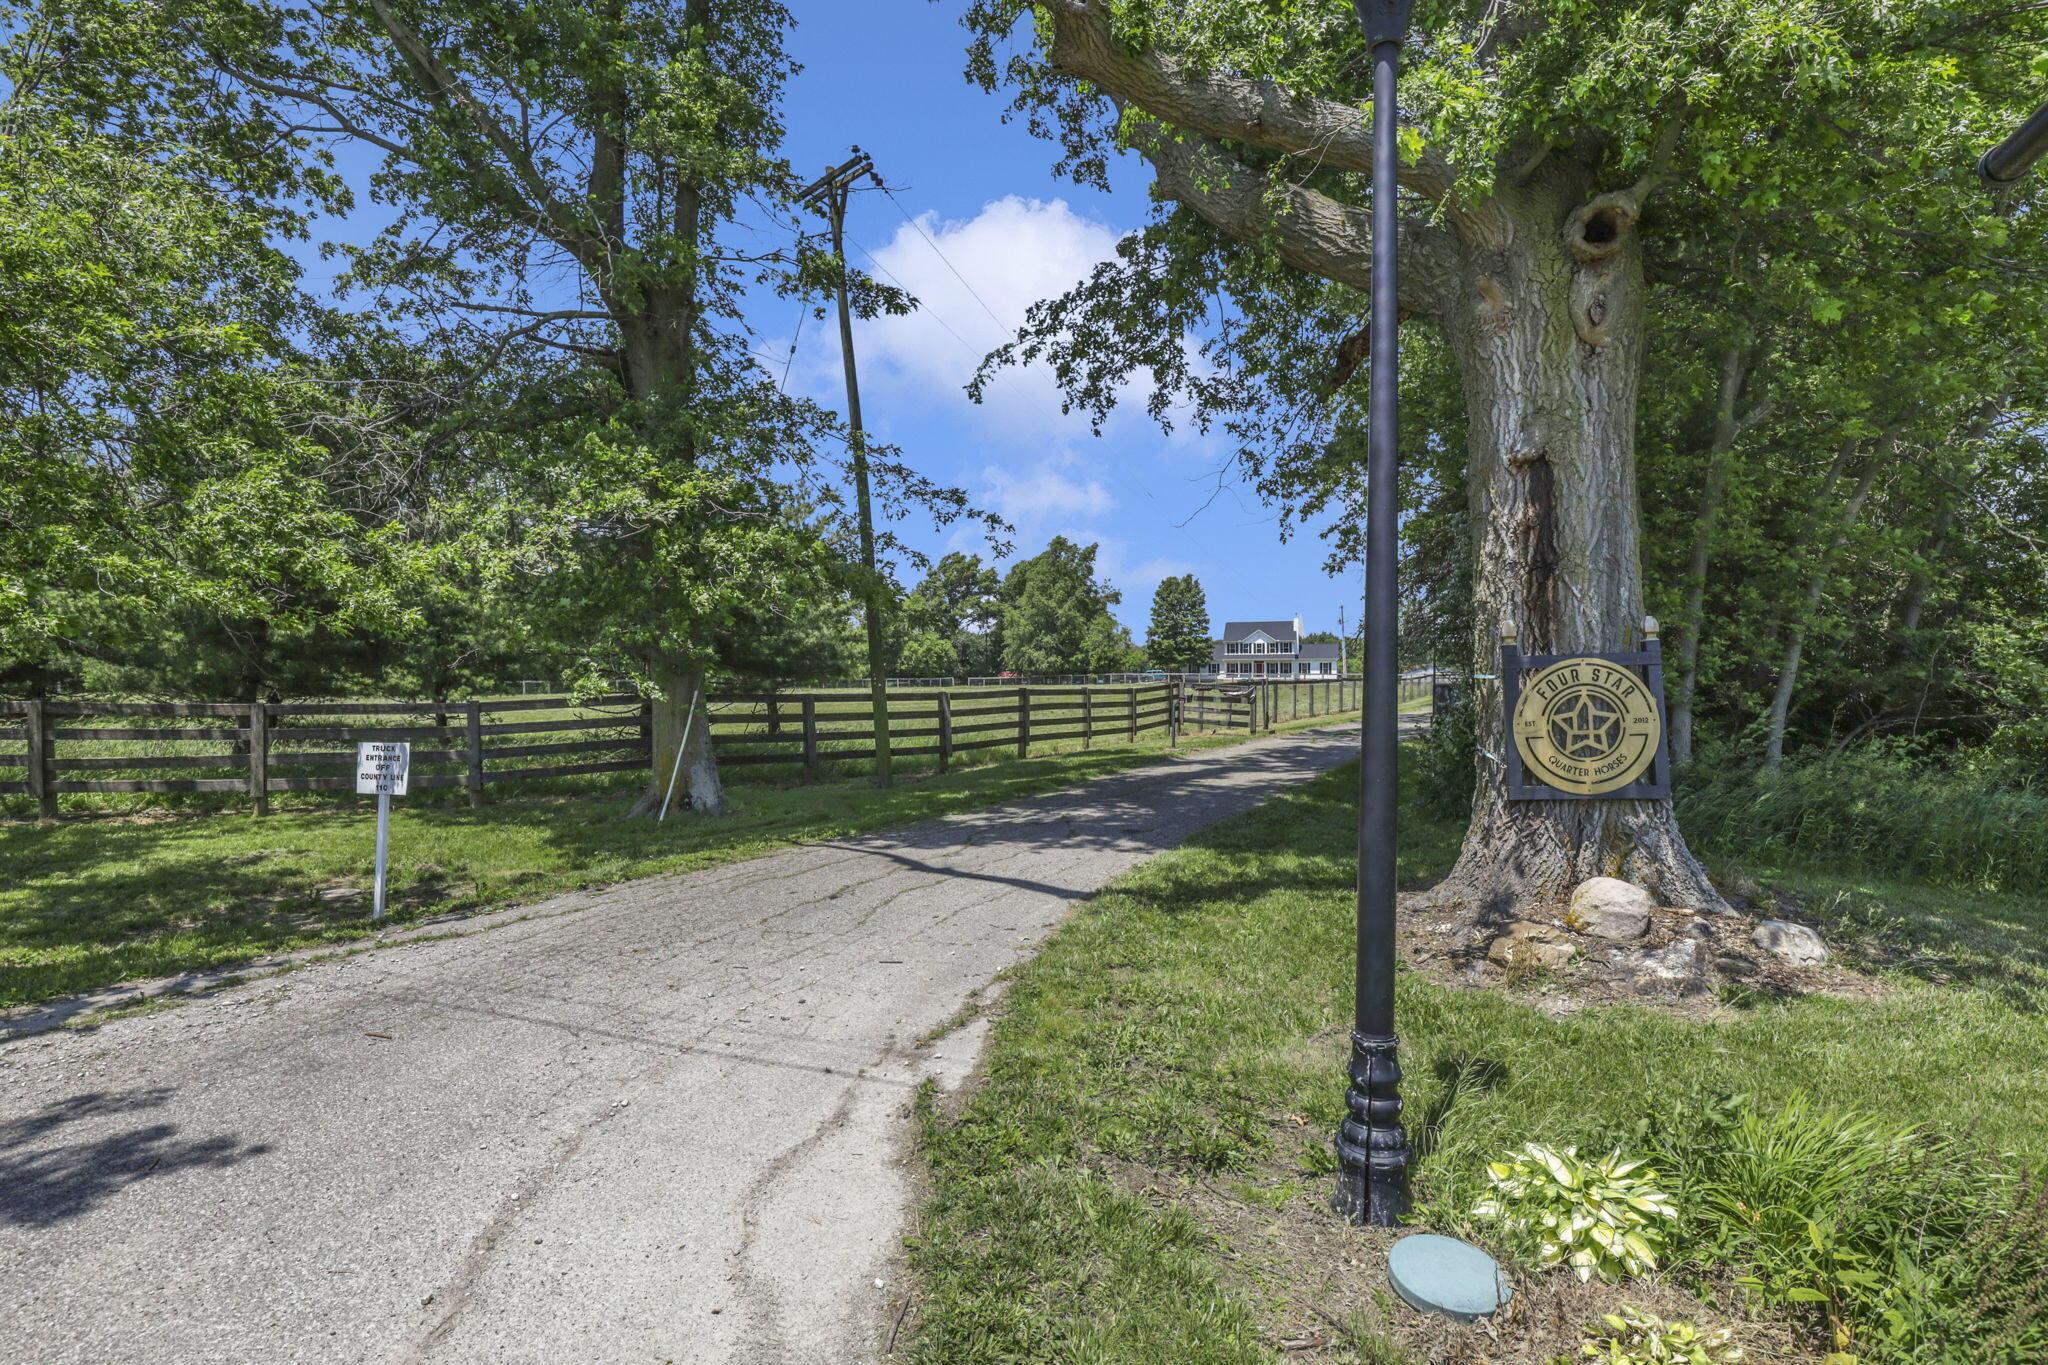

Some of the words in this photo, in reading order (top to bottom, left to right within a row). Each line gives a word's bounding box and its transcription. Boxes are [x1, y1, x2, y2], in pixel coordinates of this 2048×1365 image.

[1536, 668, 1581, 700] FOUR
[1592, 668, 1636, 699] STAR
[1548, 756, 1589, 776] QUARTER
[1594, 753, 1628, 776] HORSES
